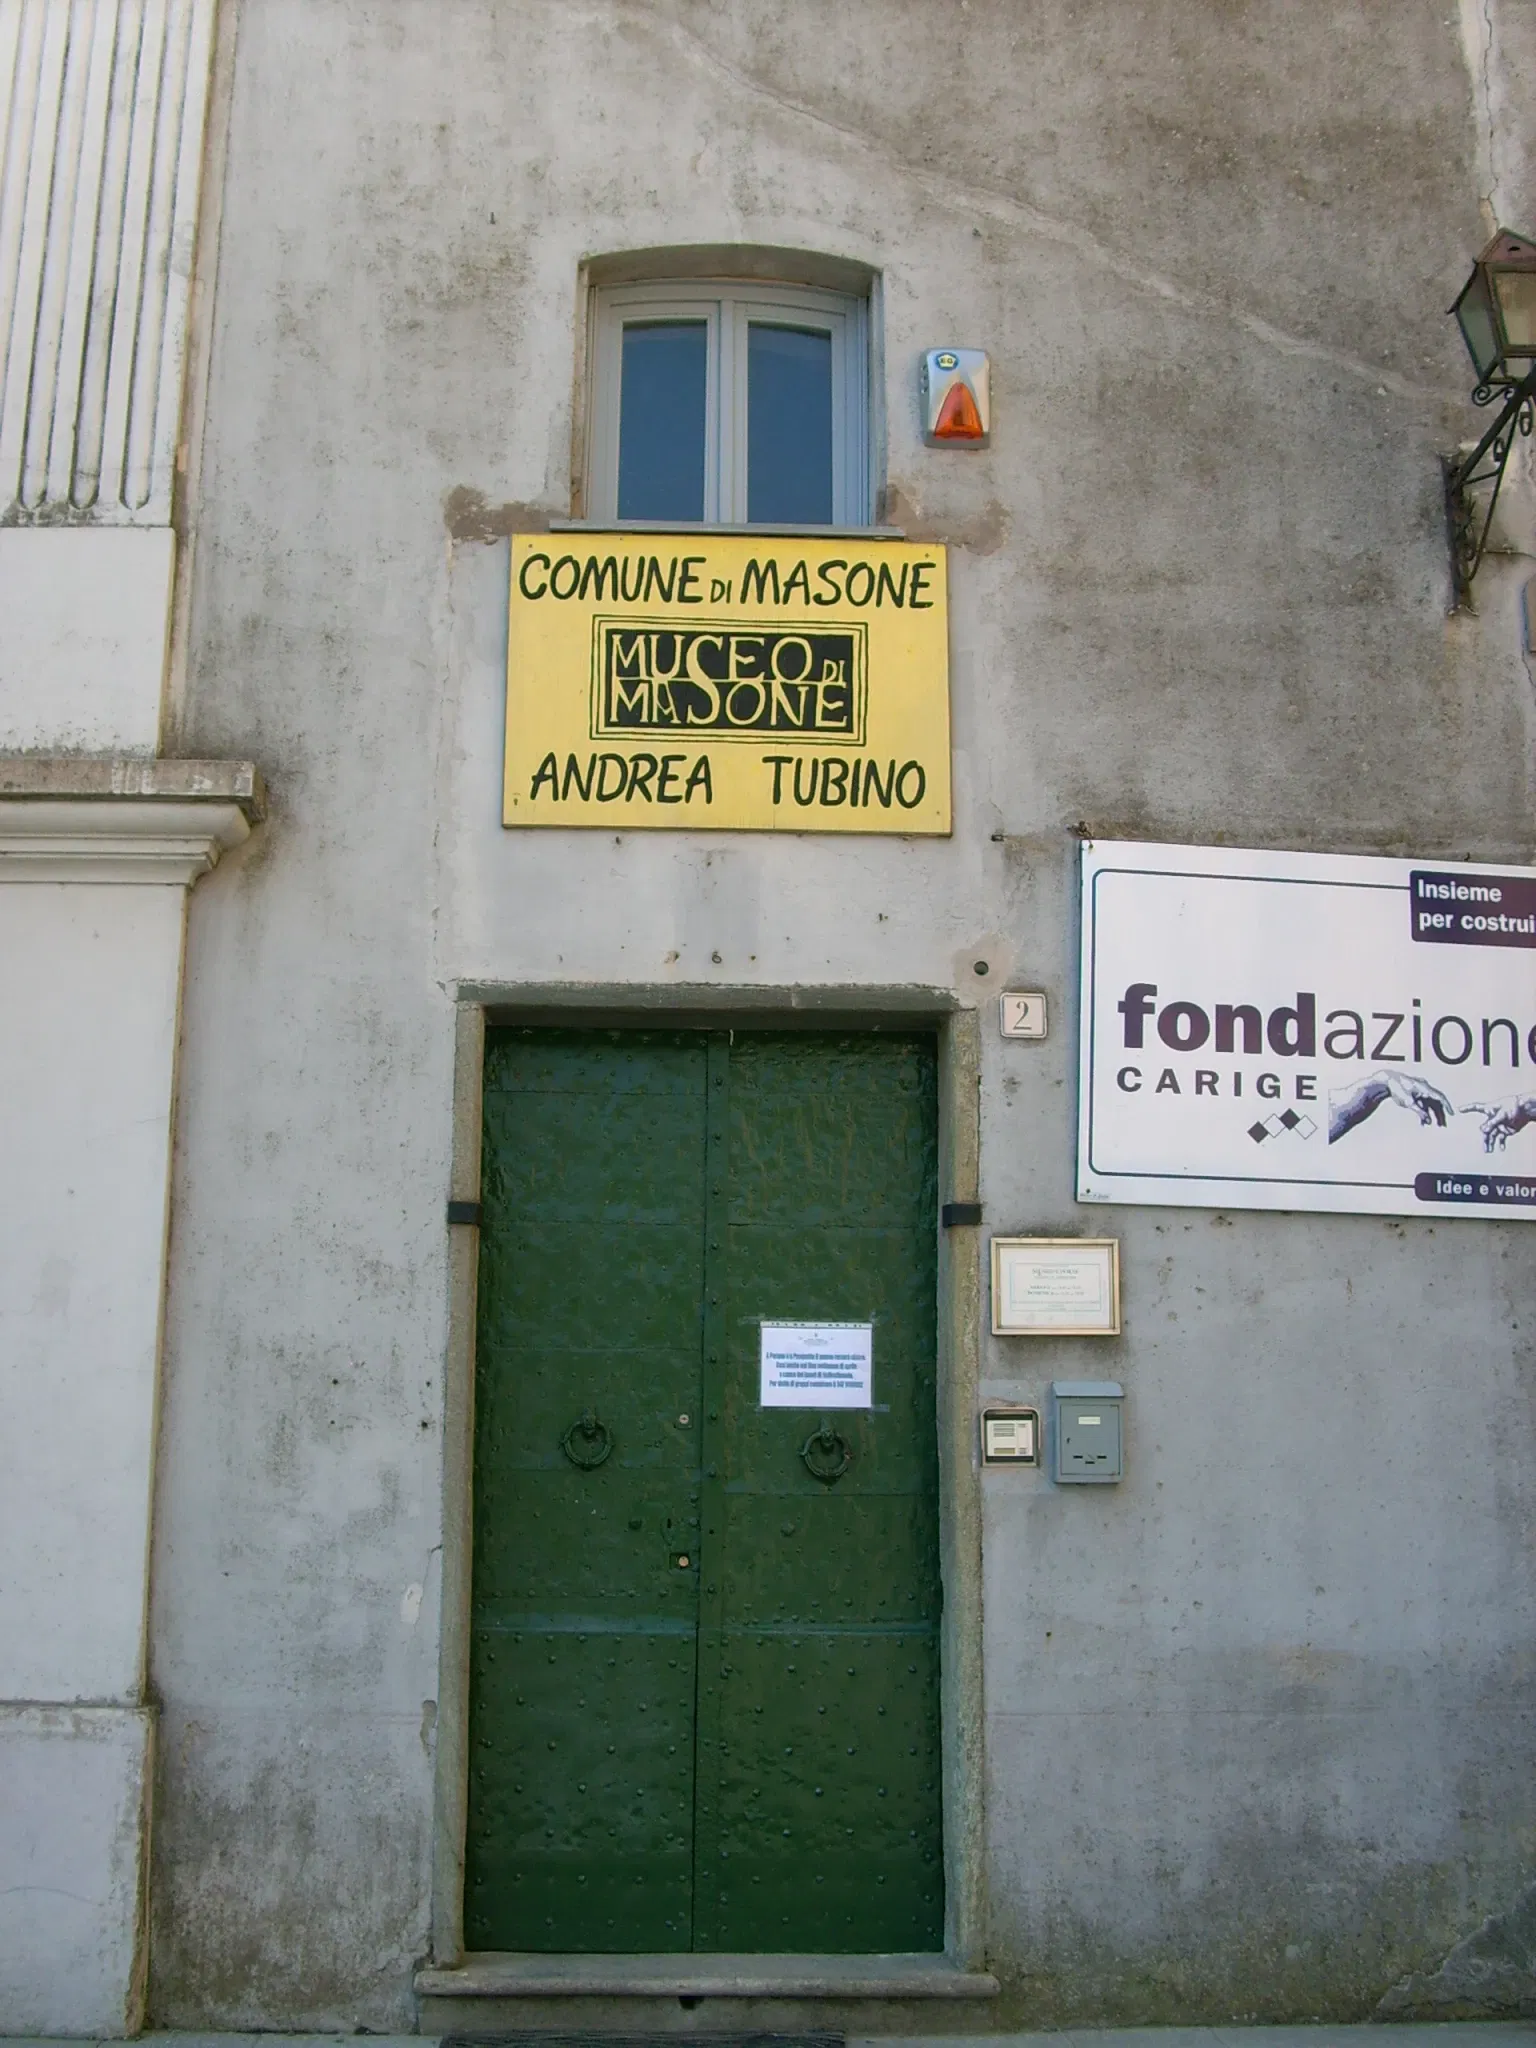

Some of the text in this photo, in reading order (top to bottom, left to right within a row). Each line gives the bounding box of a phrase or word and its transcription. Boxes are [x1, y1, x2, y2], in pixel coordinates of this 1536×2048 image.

[519, 553, 937, 609] COMUNE DI MASONE
[610, 633, 847, 686] MUSEO DI
[609, 677, 849, 728] MASONE
[529, 752, 927, 809] ANDREA TUBINO
[1417, 878, 1503, 902] Insieme
[1418, 911, 1536, 934] per costrui
[1012, 1000, 1032, 1031] 2
[1117, 982, 1536, 1069] fondazion
[1116, 1065, 1318, 1101] CARIGE
[1436, 1179, 1473, 1195] Idee
[1479, 1184, 1489, 1196] e
